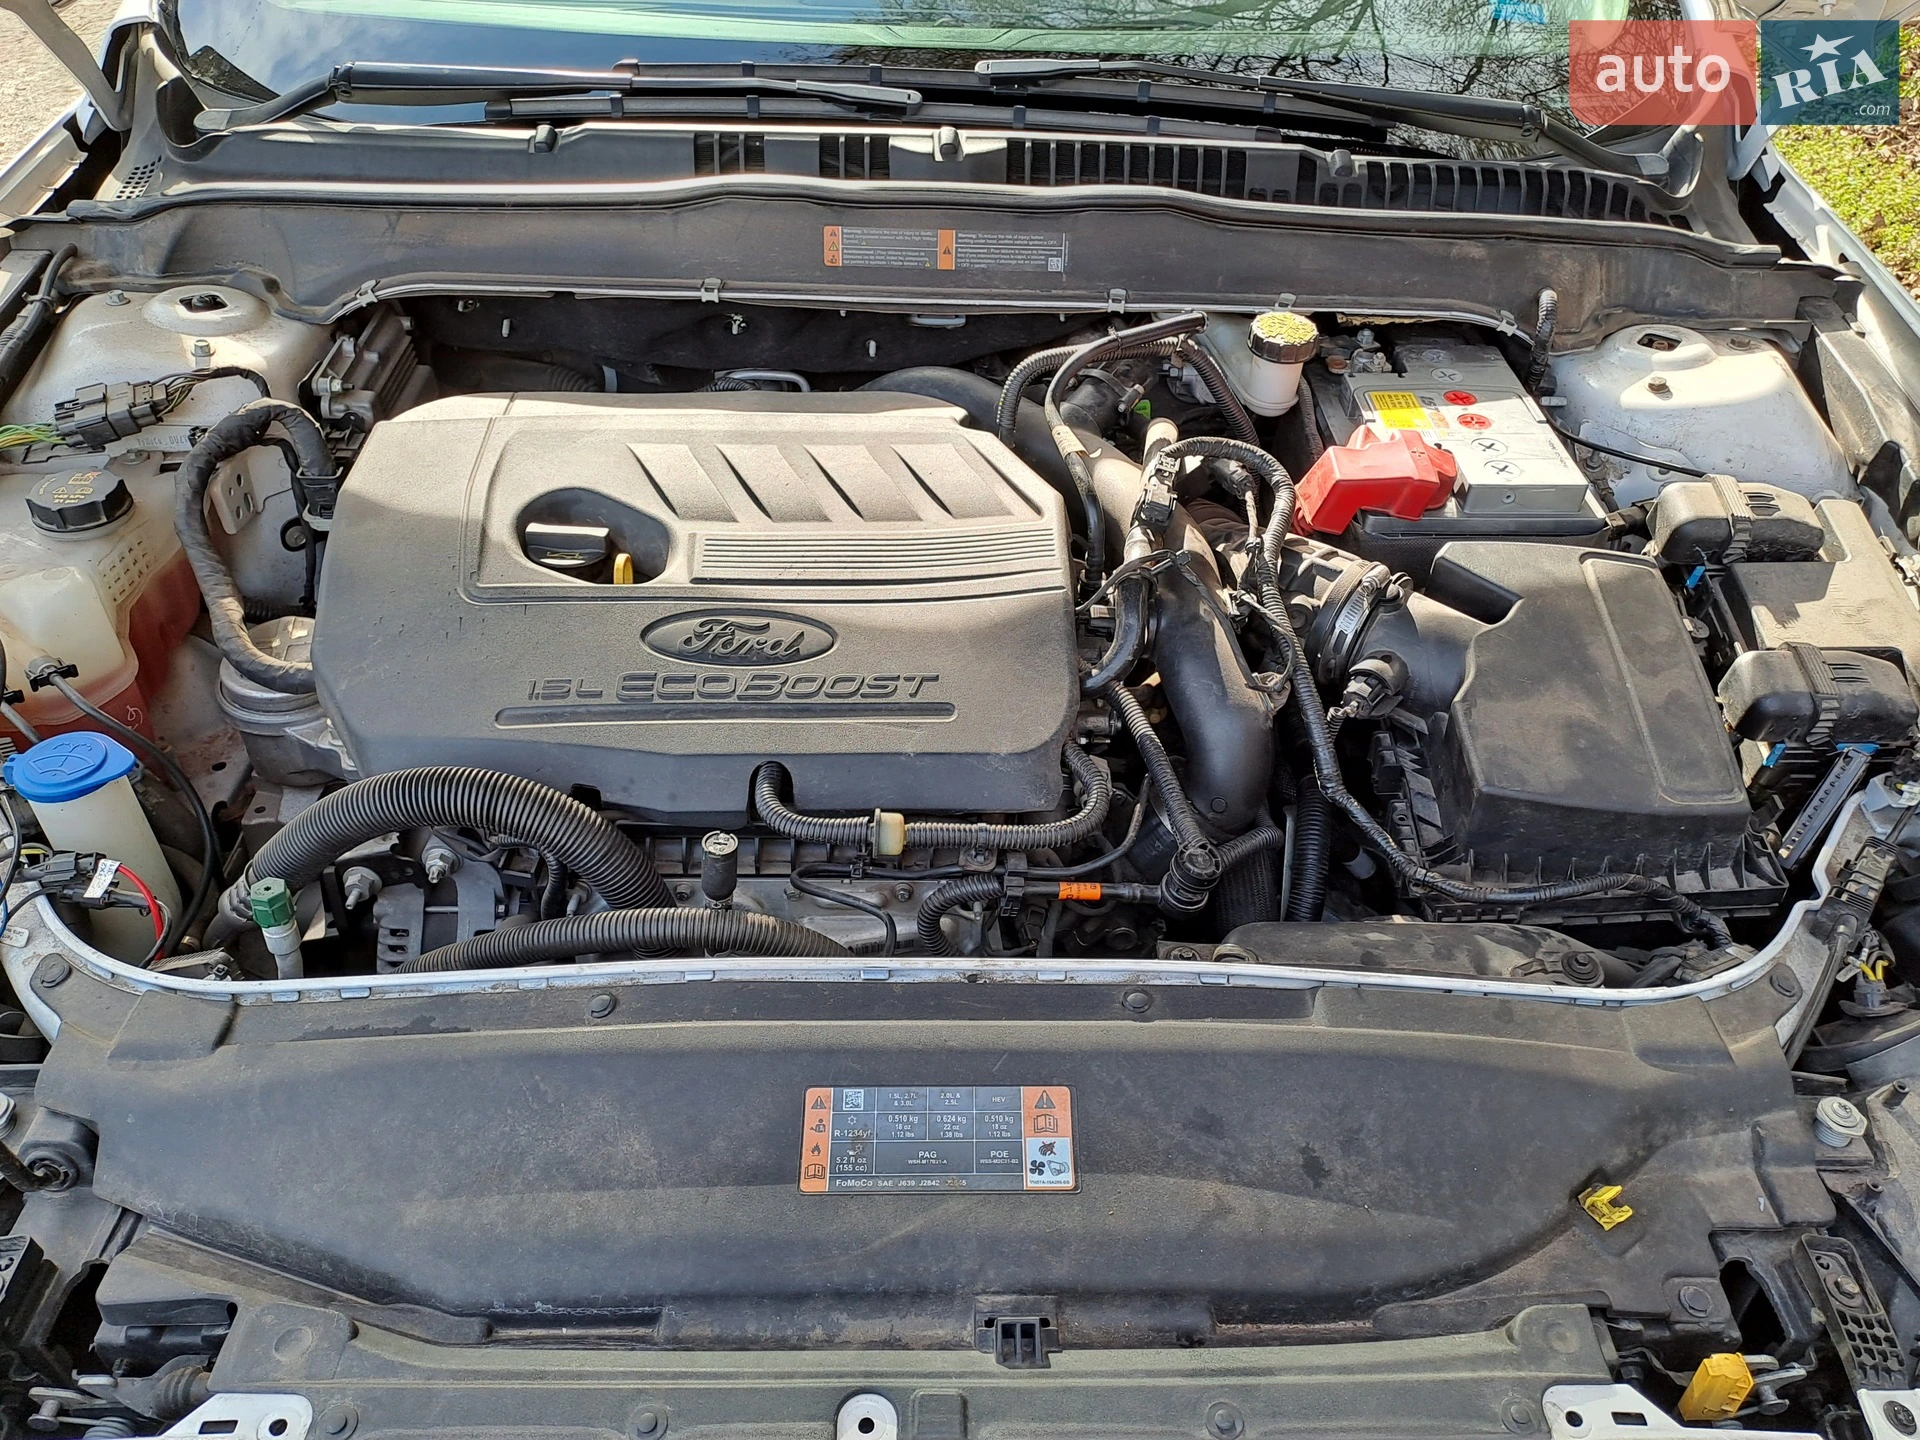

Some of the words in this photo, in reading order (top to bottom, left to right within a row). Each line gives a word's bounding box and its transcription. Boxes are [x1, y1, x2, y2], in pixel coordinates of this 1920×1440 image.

[678, 618, 806, 658] Ford
[909, 1115, 919, 1124] kg
[957, 1115, 967, 1124] kg
[1004, 1115, 1014, 1124] kg
[834, 1129, 872, 1139] R-1234yf
[918, 1150, 938, 1159] PAG
[990, 1150, 1010, 1158] POE
[835, 1156, 848, 1164] 5.2
[836, 1179, 873, 1187] FoMoCo
